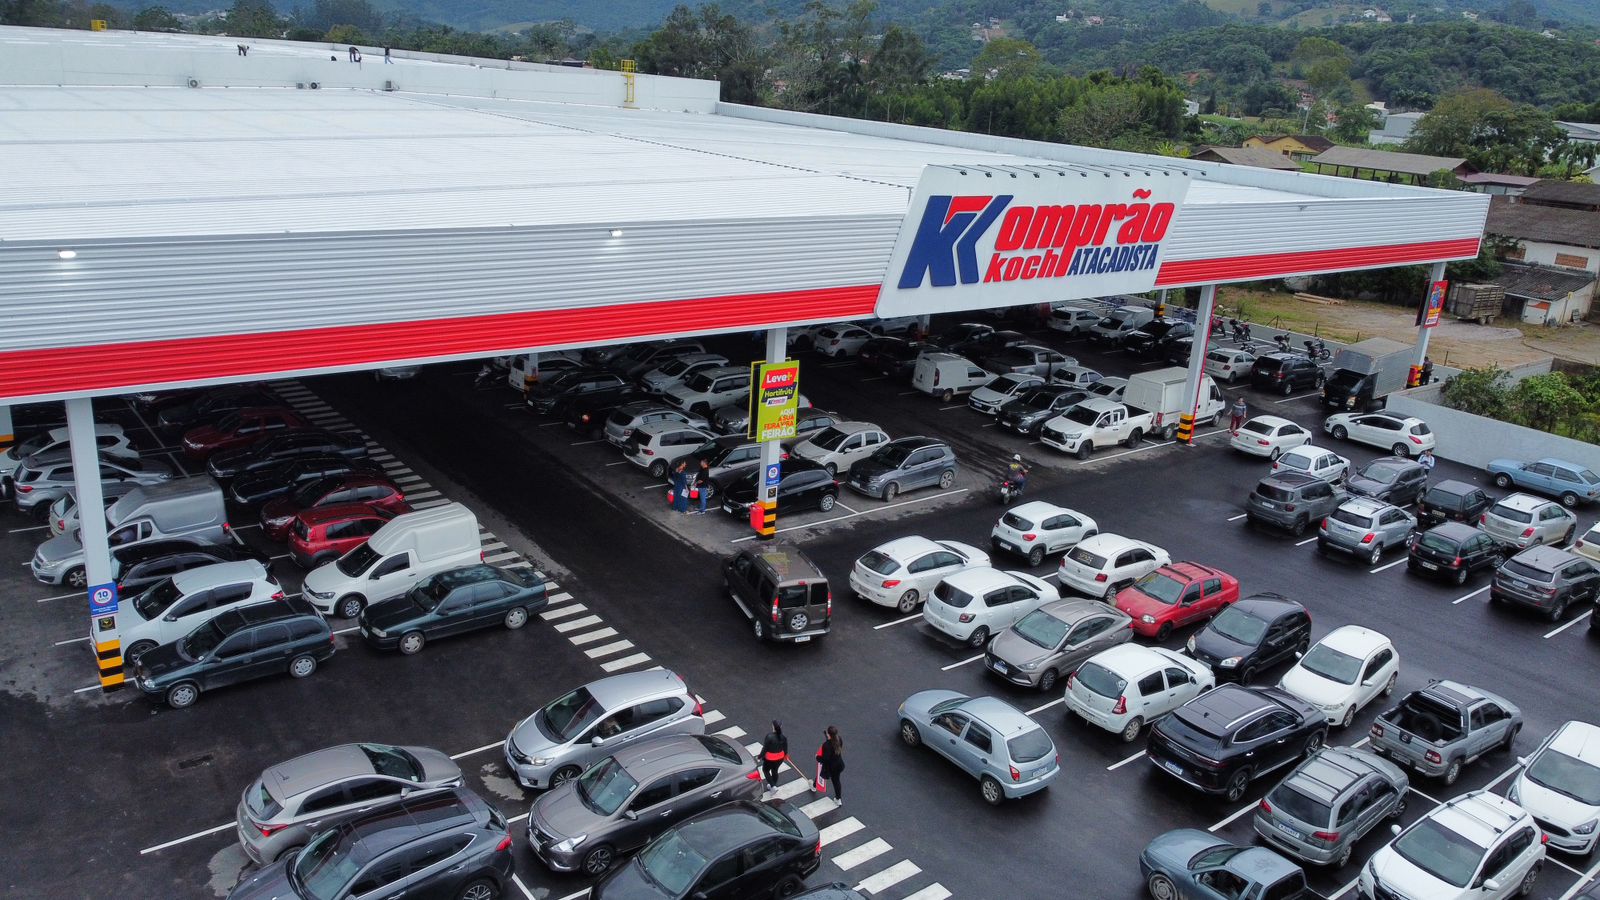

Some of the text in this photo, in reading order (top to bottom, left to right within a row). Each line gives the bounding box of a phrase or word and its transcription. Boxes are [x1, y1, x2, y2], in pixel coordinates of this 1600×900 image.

[983, 244, 1159, 283] koch ATACADISTA
[762, 426, 795, 440] FEIRÃO
